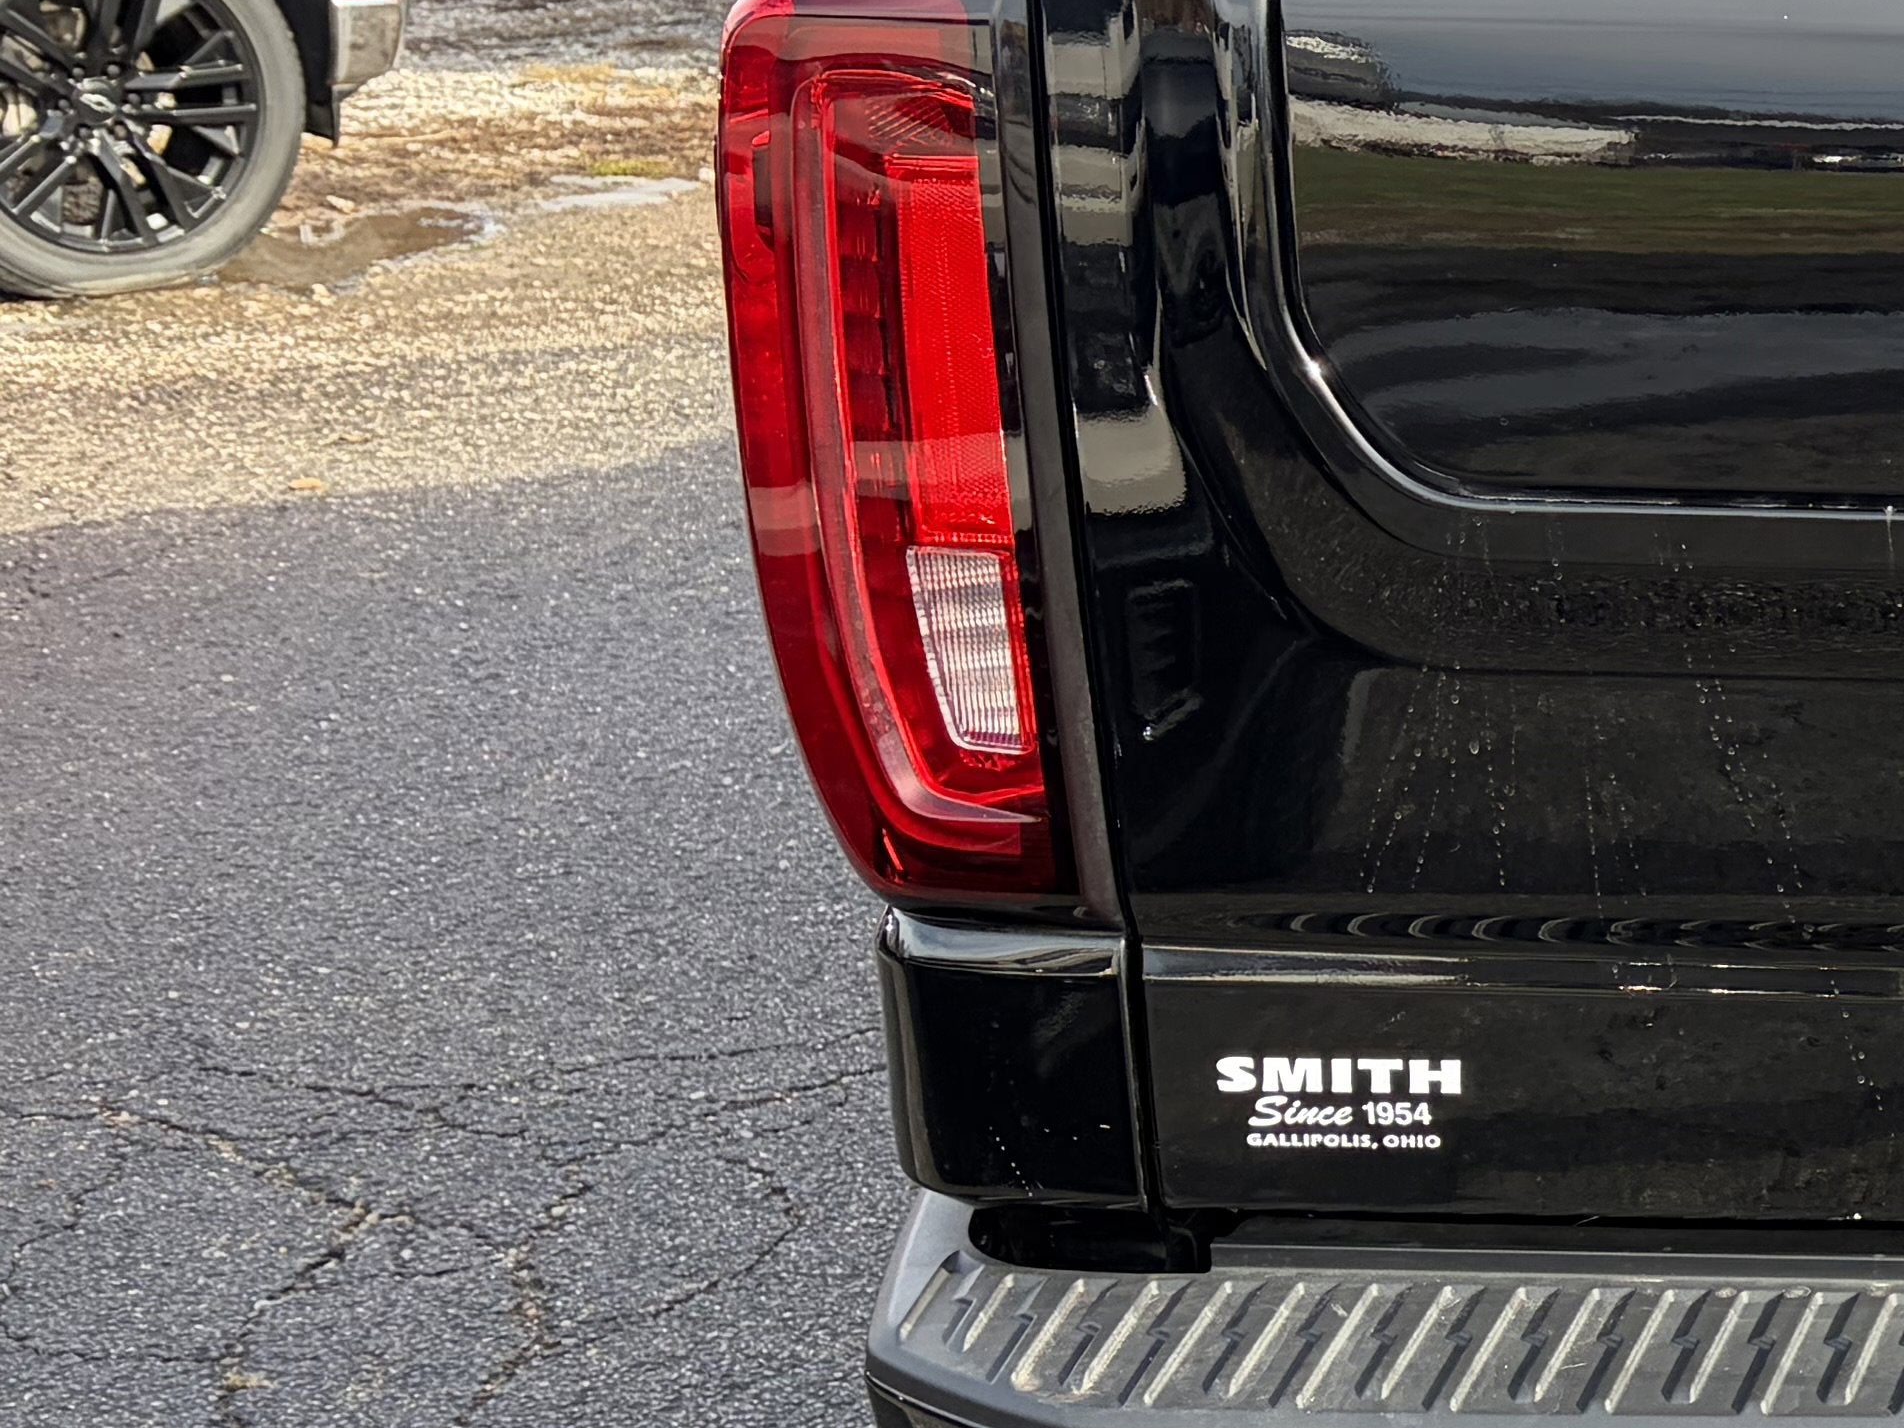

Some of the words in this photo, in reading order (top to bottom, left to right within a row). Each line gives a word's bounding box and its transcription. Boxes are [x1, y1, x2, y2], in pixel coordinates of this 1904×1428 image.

[1216, 1056, 1462, 1094] SMITH
[1248, 1095, 1353, 1126] Since
[1361, 1101, 1432, 1125] 1954
[1246, 1133, 1379, 1150] GALLIPOLIS,
[1382, 1134, 1441, 1148] OHIO
